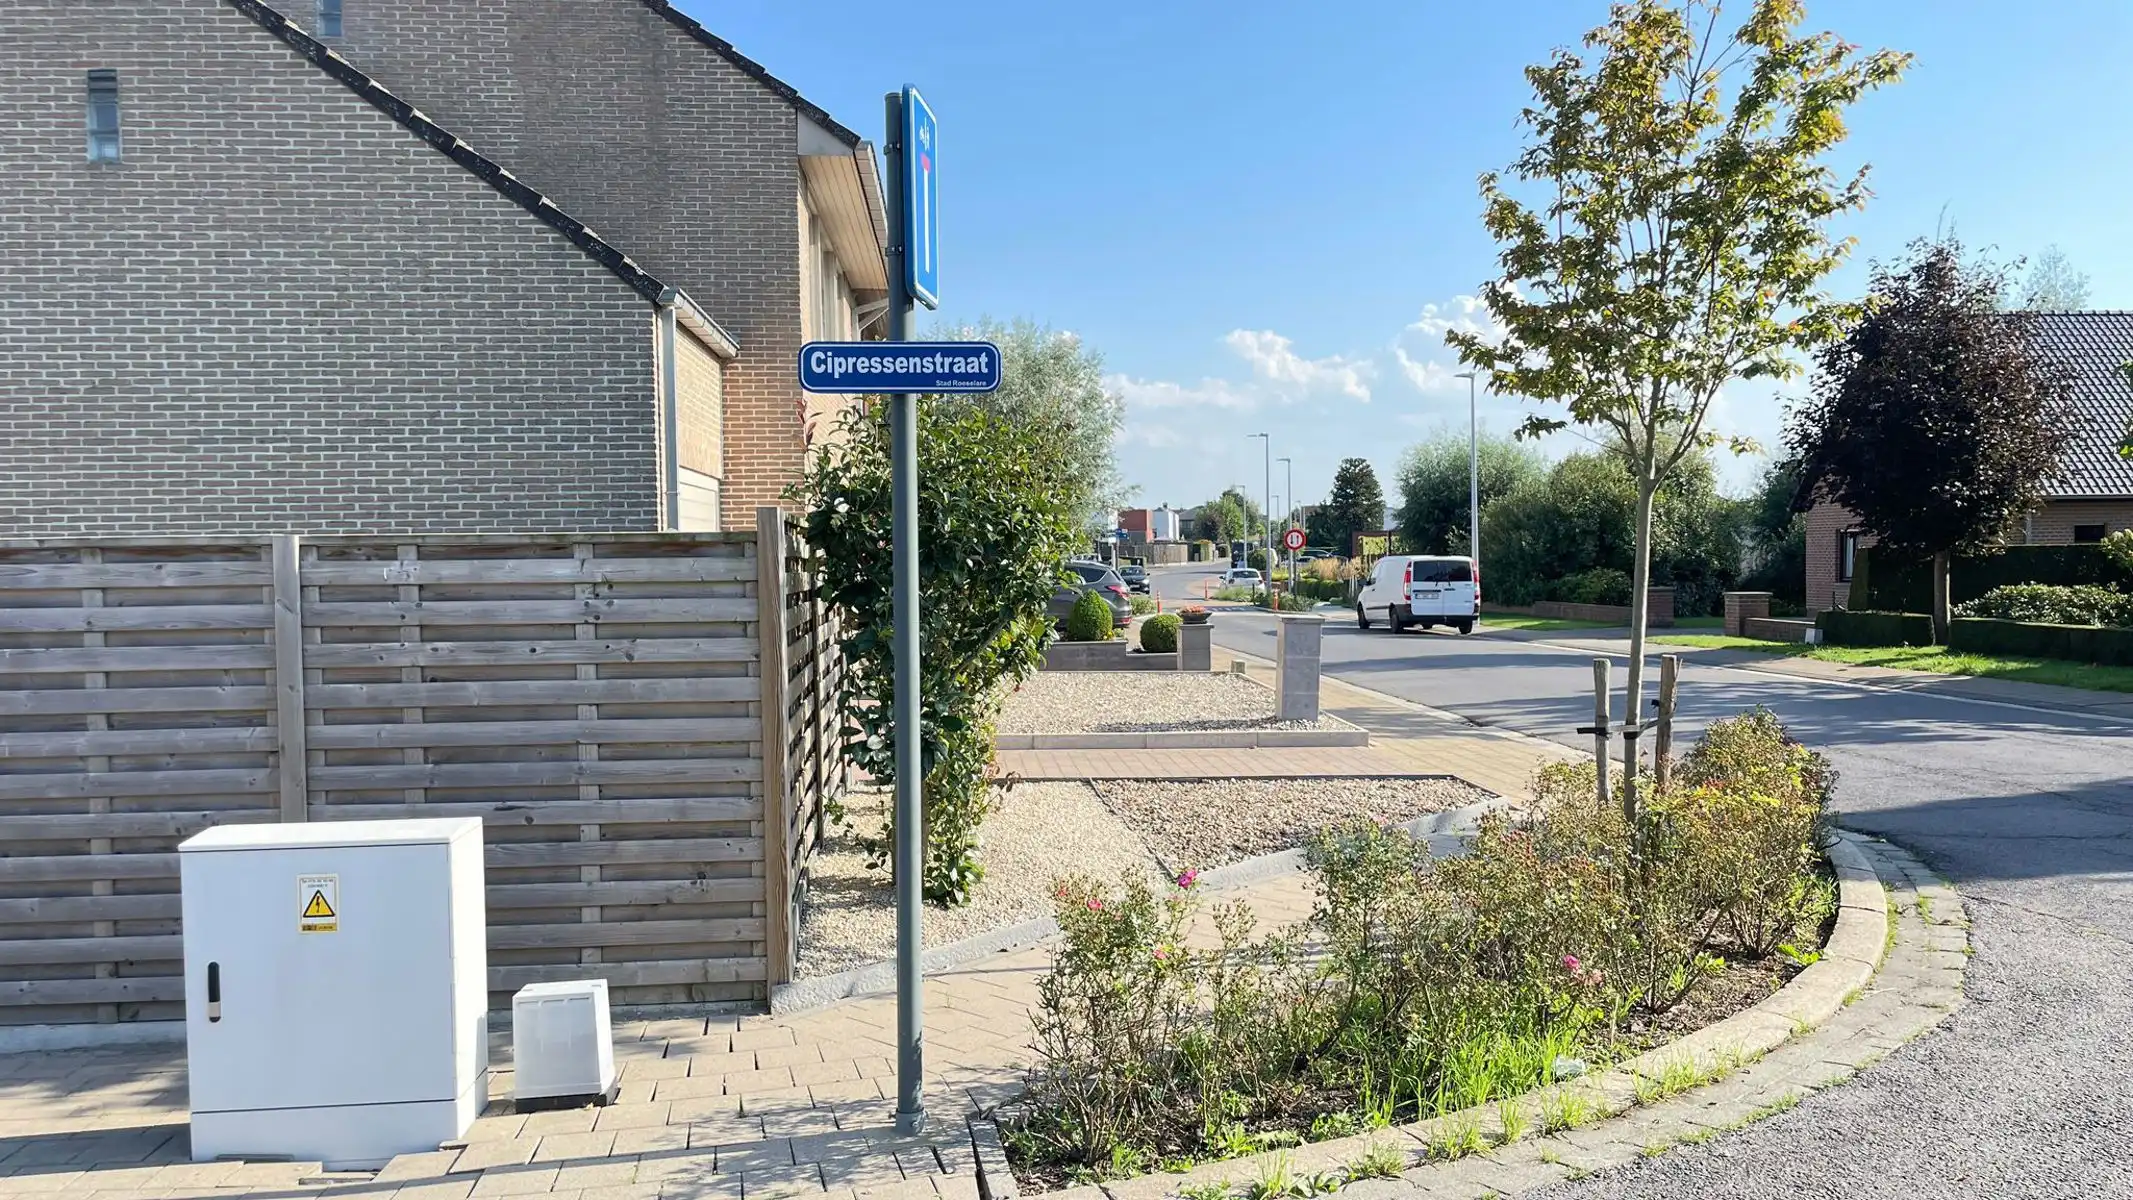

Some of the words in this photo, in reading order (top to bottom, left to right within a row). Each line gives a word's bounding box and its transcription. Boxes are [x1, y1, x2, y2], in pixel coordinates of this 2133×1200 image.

[810, 351, 989, 379] Cipressenstraat
[935, 379, 952, 387] Stad
[952, 379, 987, 387] Roeselare
